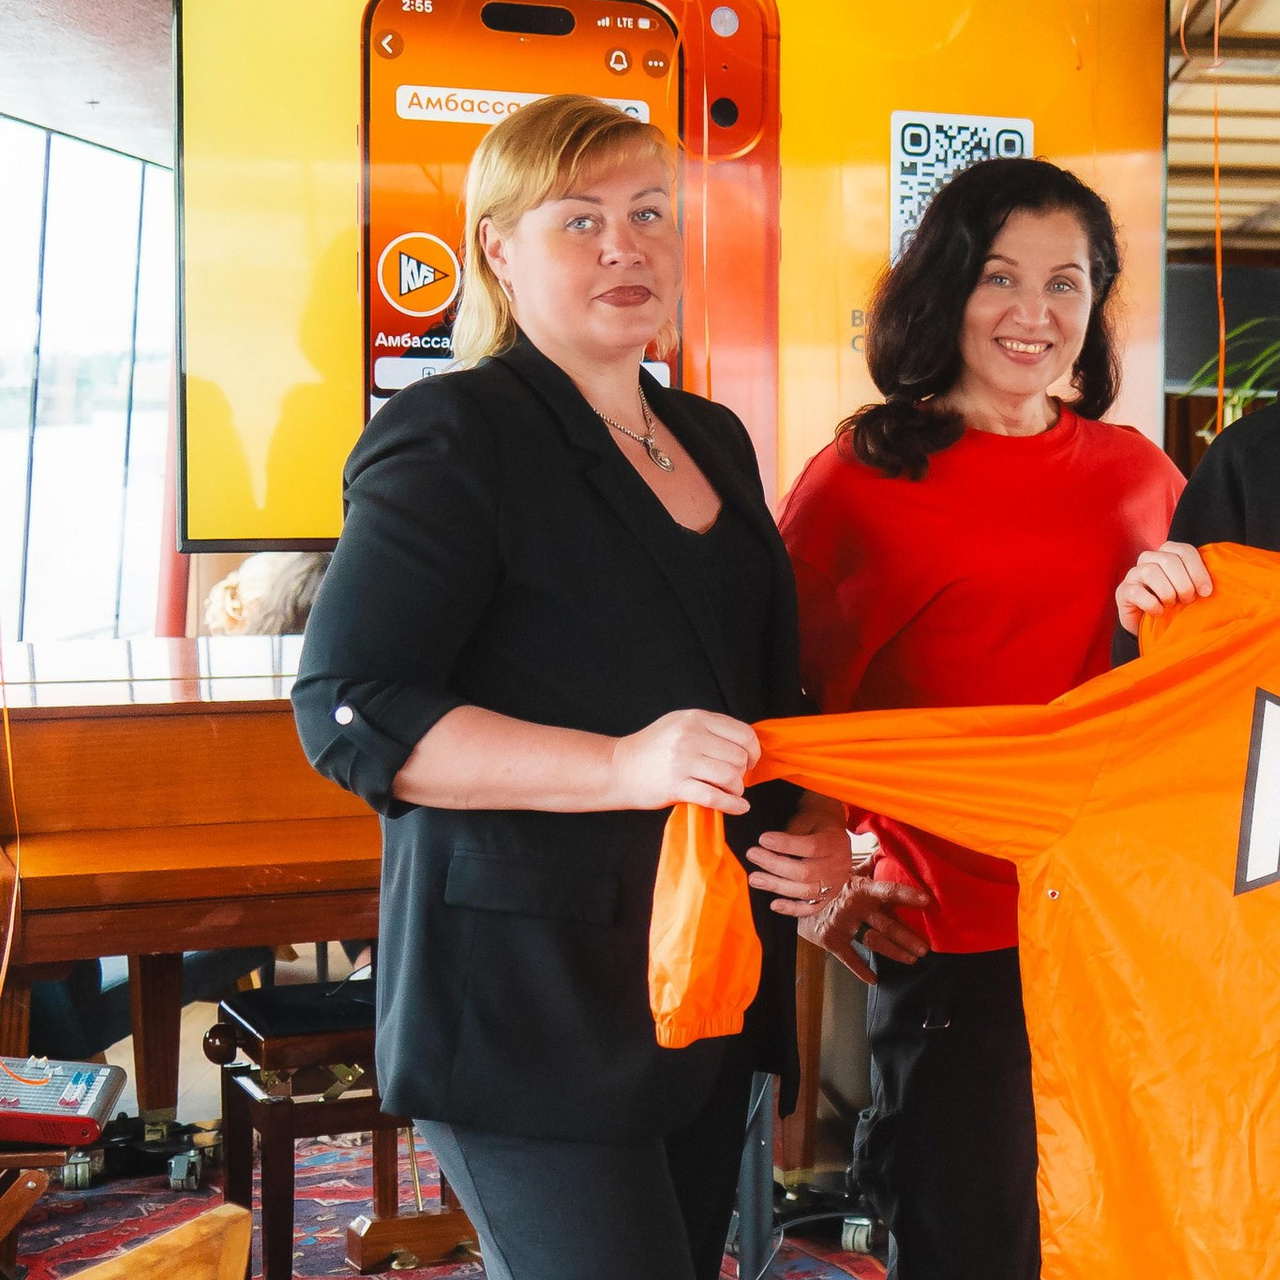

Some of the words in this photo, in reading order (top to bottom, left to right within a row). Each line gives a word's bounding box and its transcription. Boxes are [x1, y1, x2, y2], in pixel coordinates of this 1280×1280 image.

[616, 16, 634, 30] LTE
[407, 91, 521, 116] Амбасса
[400, 253, 435, 296] KVS
[374, 331, 454, 352] Амбасса
